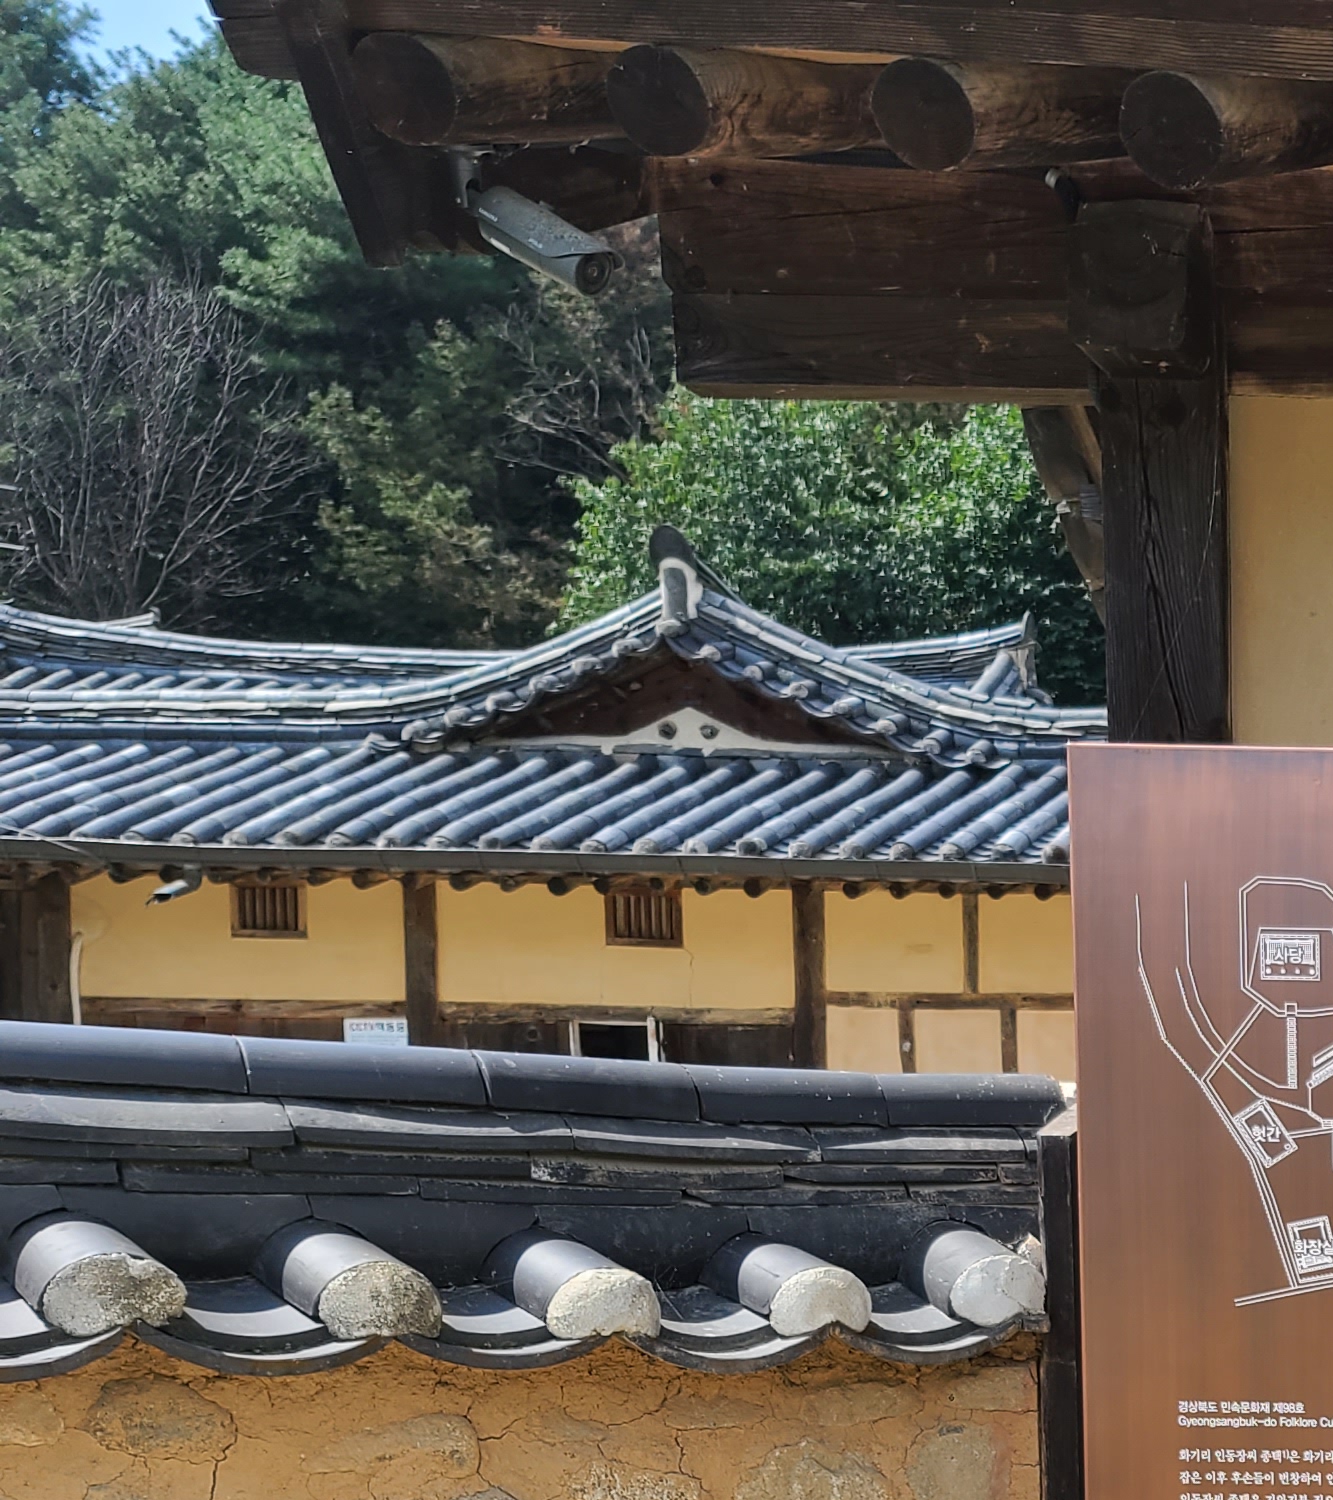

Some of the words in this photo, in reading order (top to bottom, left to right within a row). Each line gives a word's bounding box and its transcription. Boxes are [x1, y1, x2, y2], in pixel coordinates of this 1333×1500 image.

[1274, 945, 1304, 964] 사당
[1252, 1124, 1280, 1143] 헛간
[1178, 1400, 1218, 1414] 경상북도
[1220, 1400, 1270, 1413] 민속문화재
[1177, 1415, 1277, 1428] Gyeongsangbuk-do
[1279, 1416, 1317, 1427] Folklore
[1179, 1470, 1202, 1484] 잡은
[1204, 1470, 1228, 1484] 이후
[1230, 1470, 1274, 1485] 후손들이
